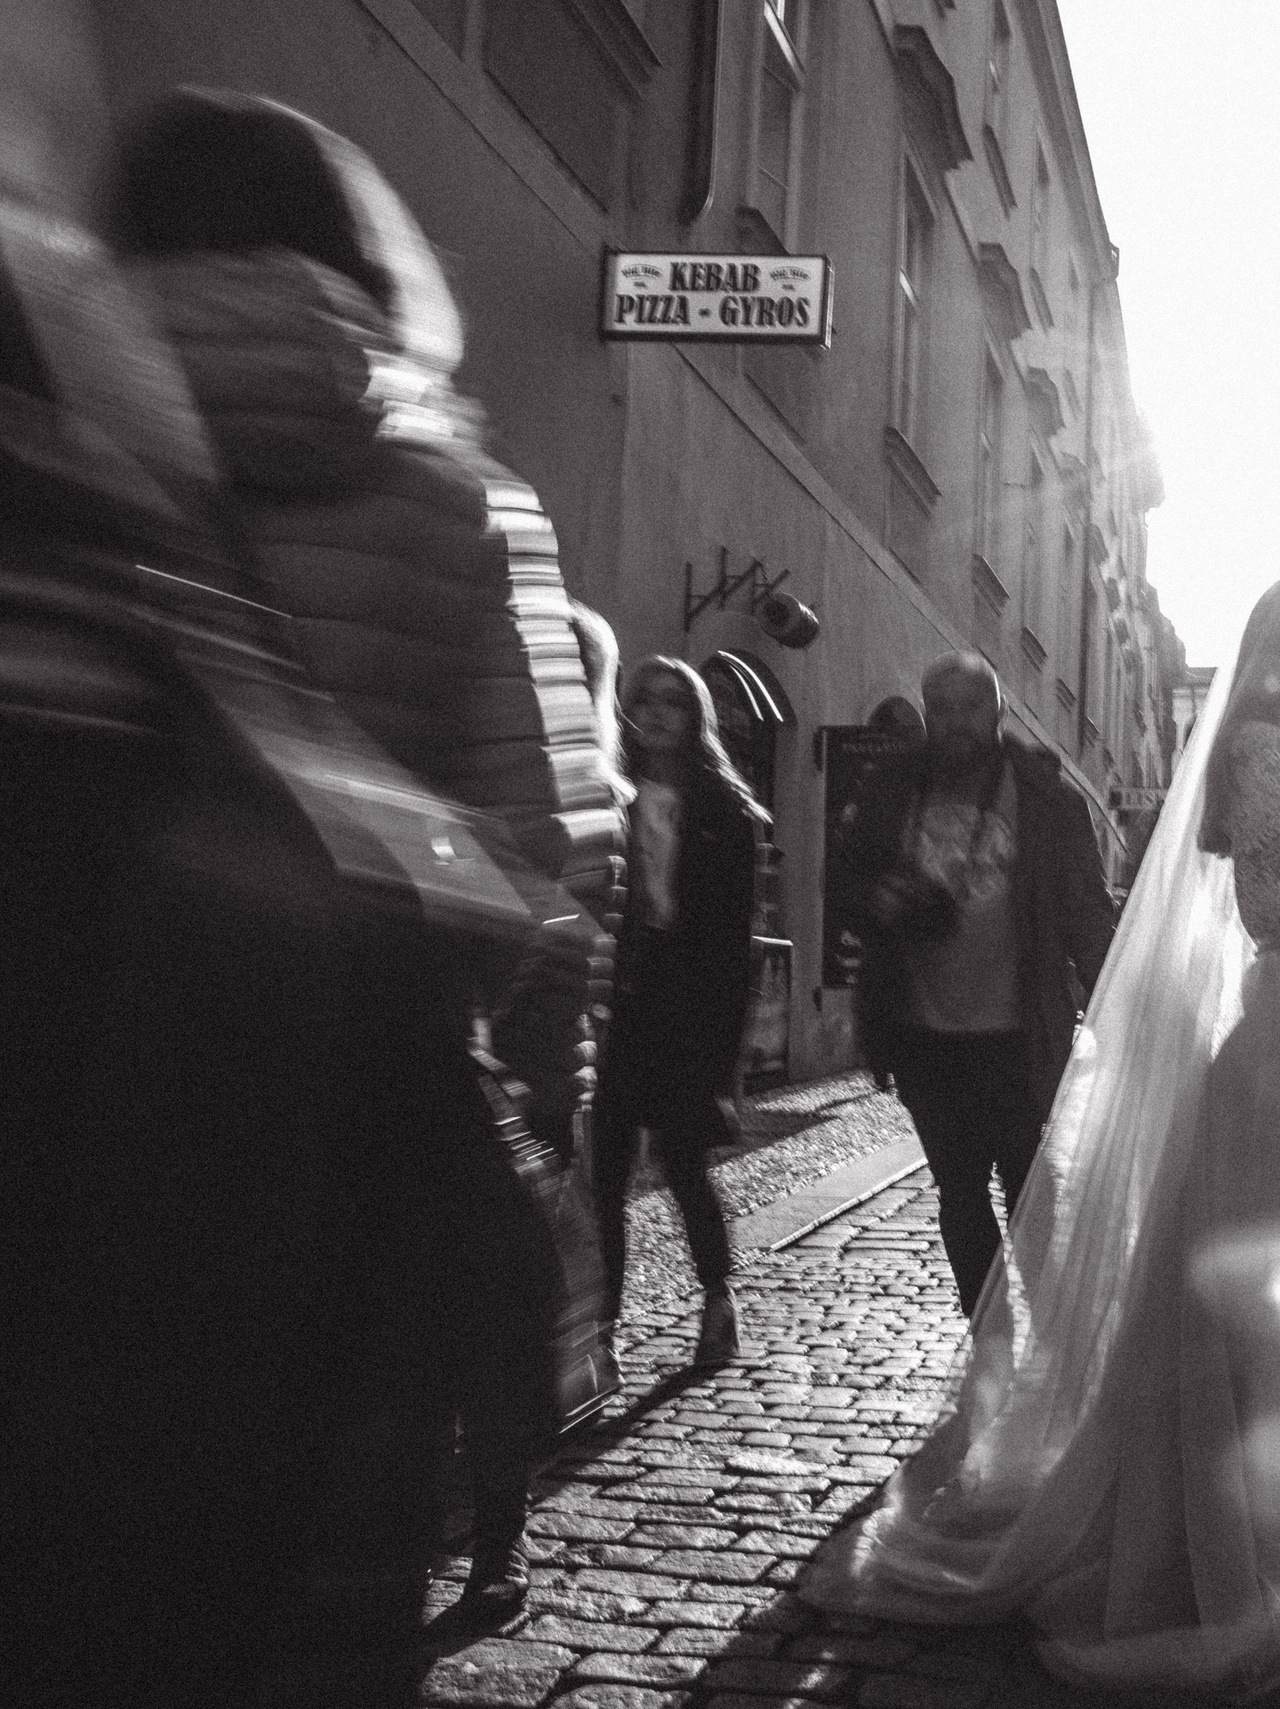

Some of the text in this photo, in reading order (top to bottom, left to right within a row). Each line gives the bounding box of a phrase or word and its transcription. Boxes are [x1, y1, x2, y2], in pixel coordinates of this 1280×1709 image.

[668, 261, 762, 293] KEBAB
[614, 293, 691, 326] PIZZA
[718, 295, 811, 328] GYROS
